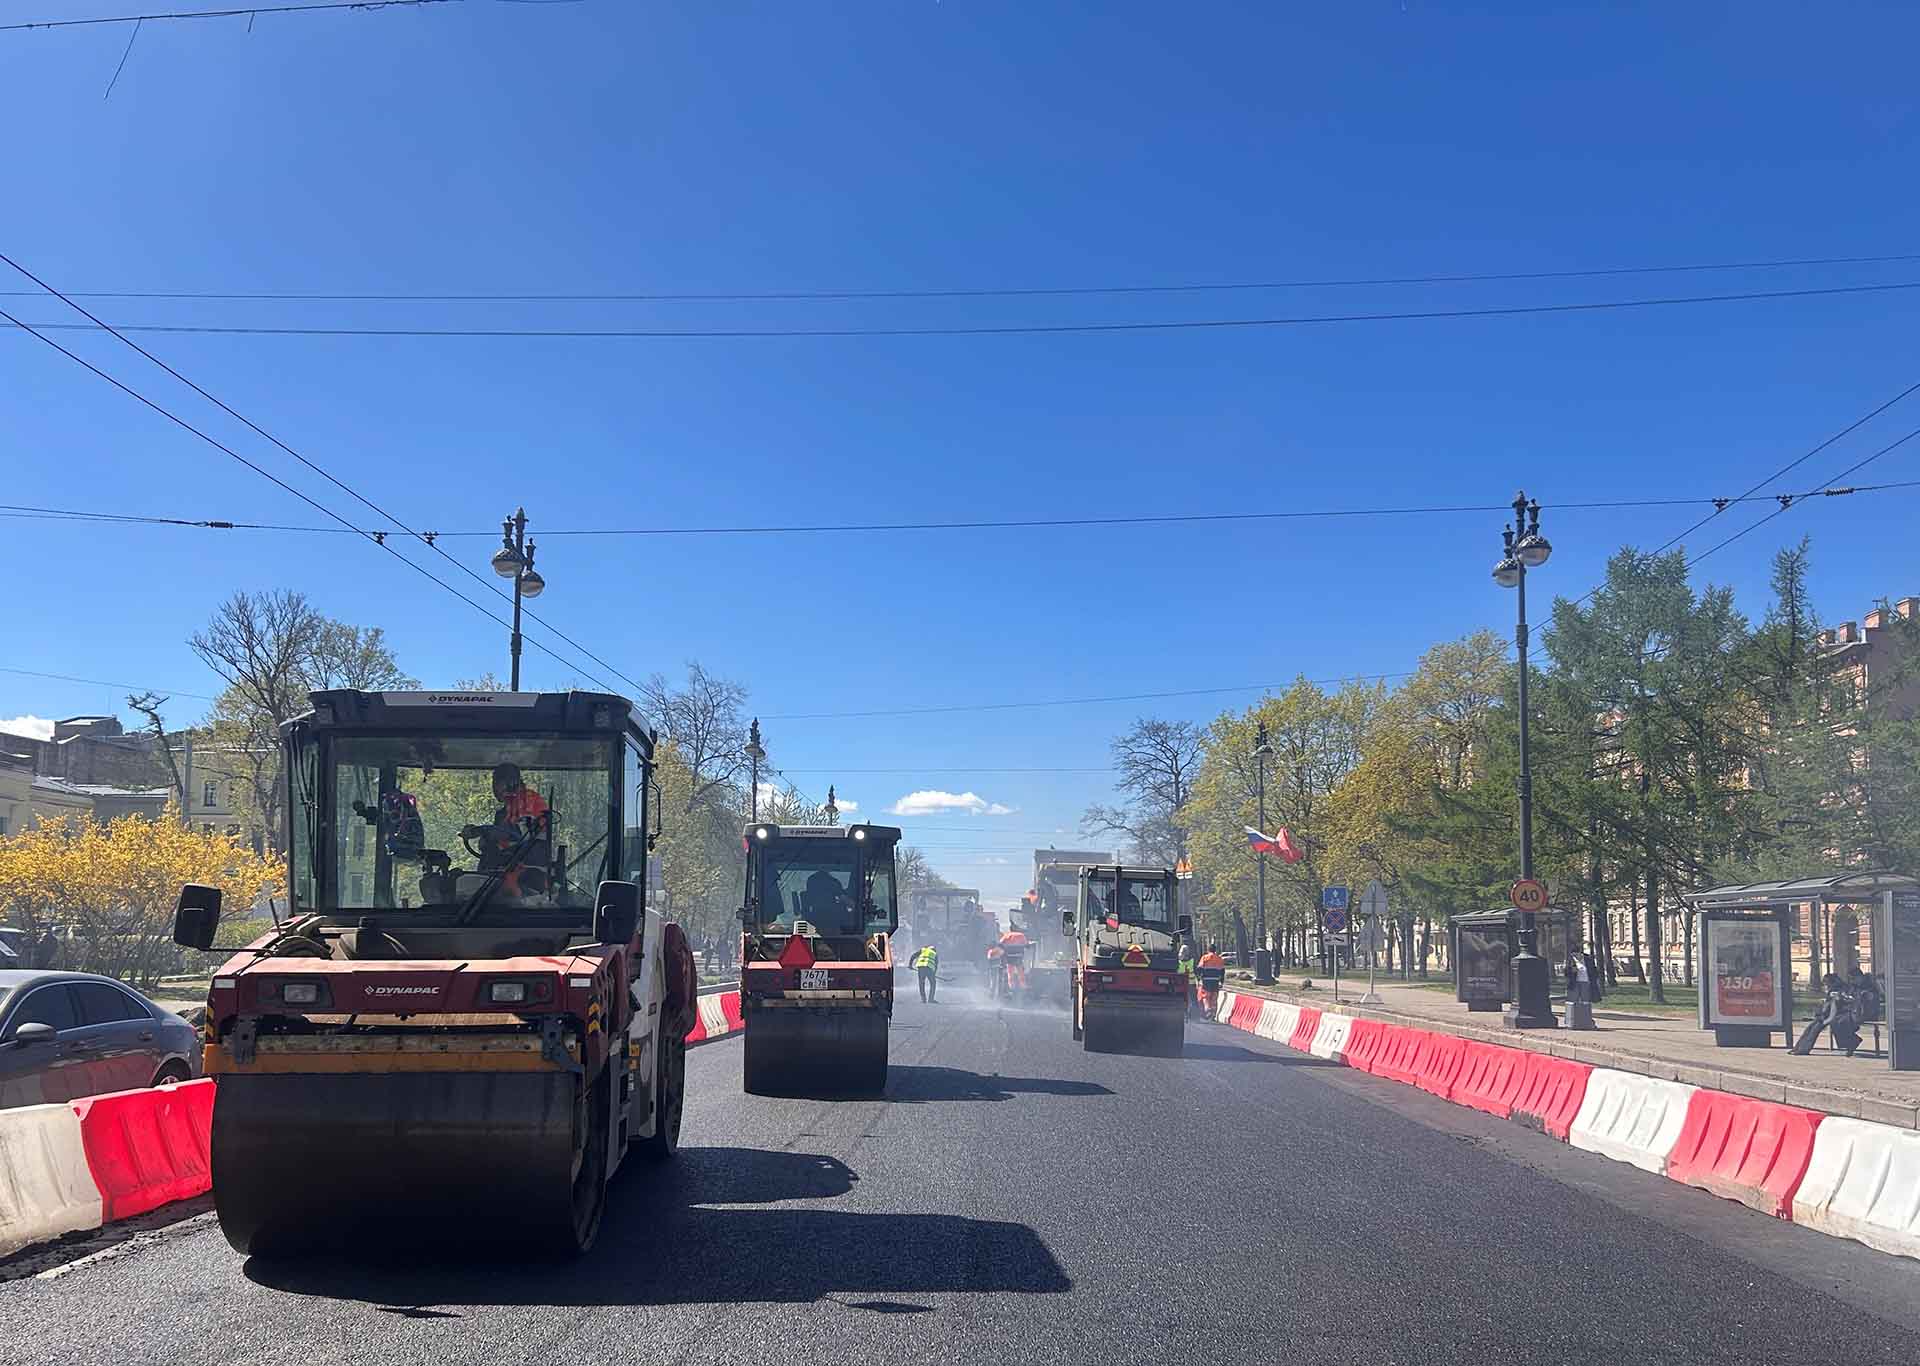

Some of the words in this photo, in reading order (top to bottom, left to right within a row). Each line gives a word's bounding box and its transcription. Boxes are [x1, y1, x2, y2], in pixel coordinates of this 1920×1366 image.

[438, 695, 495, 703] DYNAPAC
[1519, 889, 1539, 902] 40
[804, 970, 825, 980] 7677
[375, 986, 441, 994] DYNAPAC
